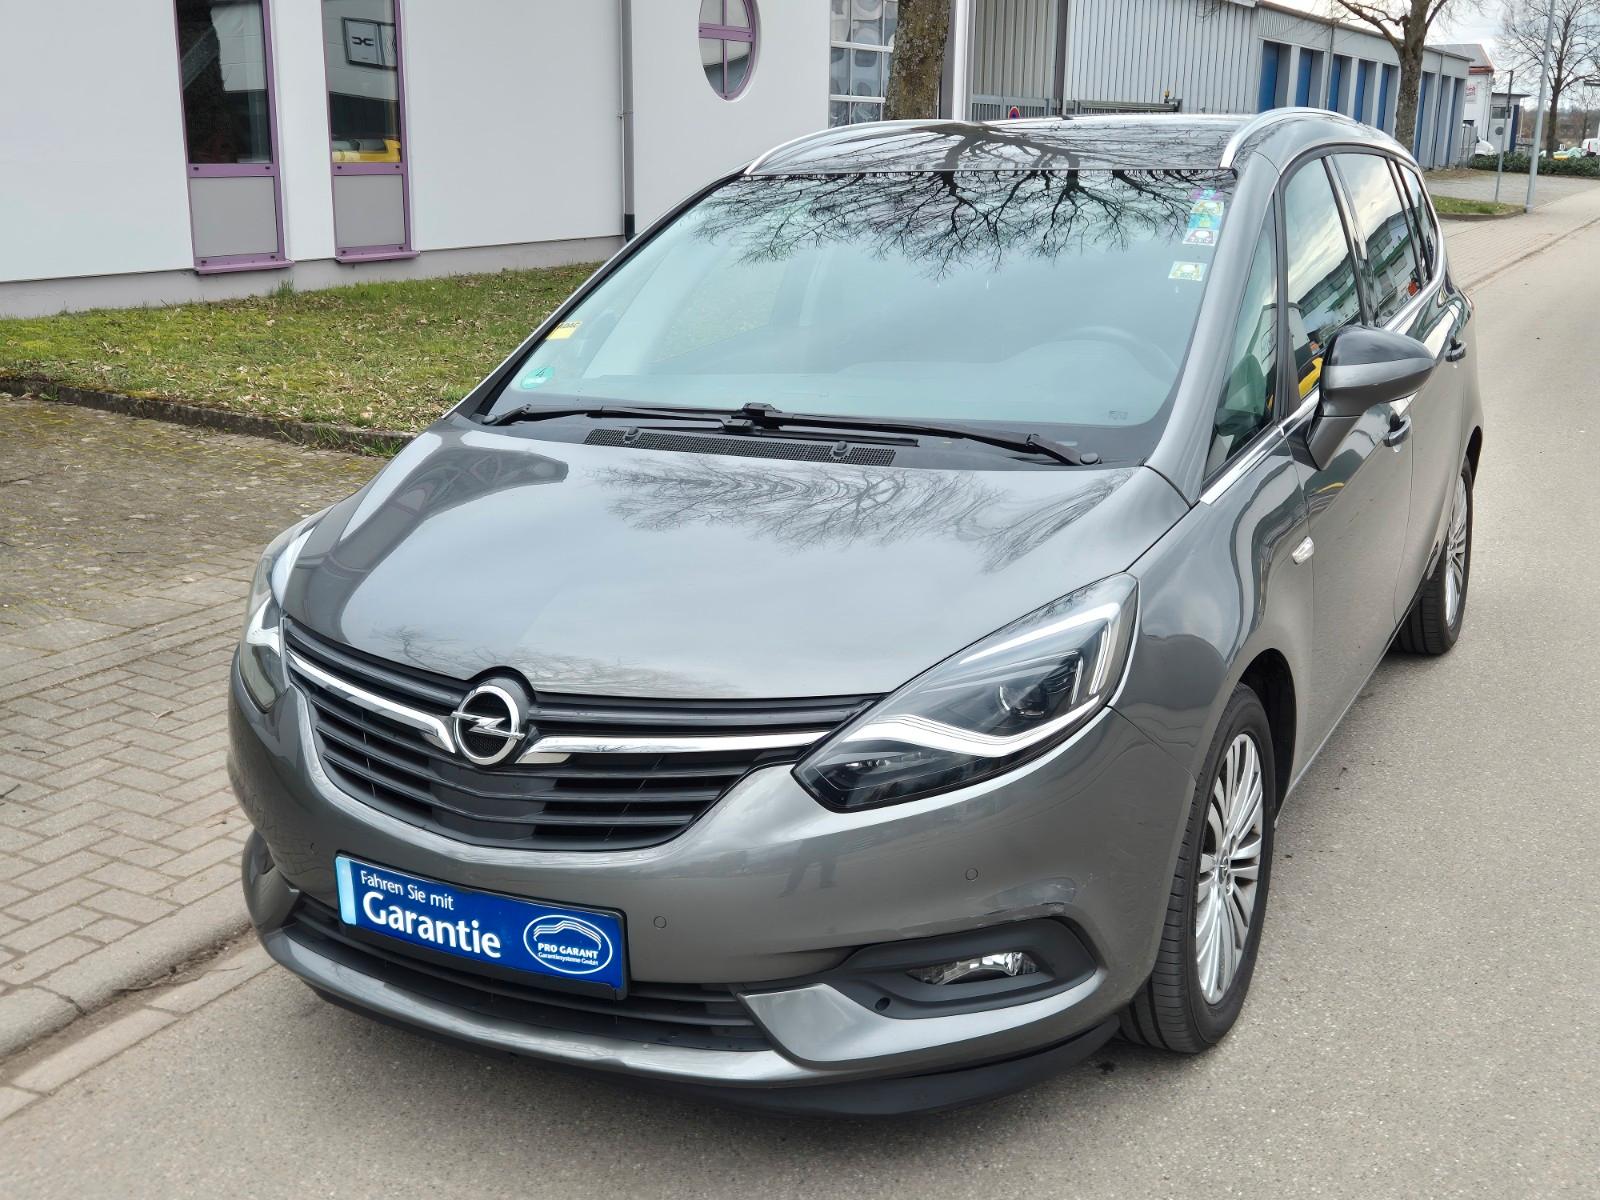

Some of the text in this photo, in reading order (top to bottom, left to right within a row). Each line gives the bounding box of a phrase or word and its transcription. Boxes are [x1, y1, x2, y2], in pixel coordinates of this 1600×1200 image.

[360, 870, 454, 911] Fahren Sie mit
[362, 891, 501, 958] Garantie
[537, 942, 599, 960] PRO GARANT
